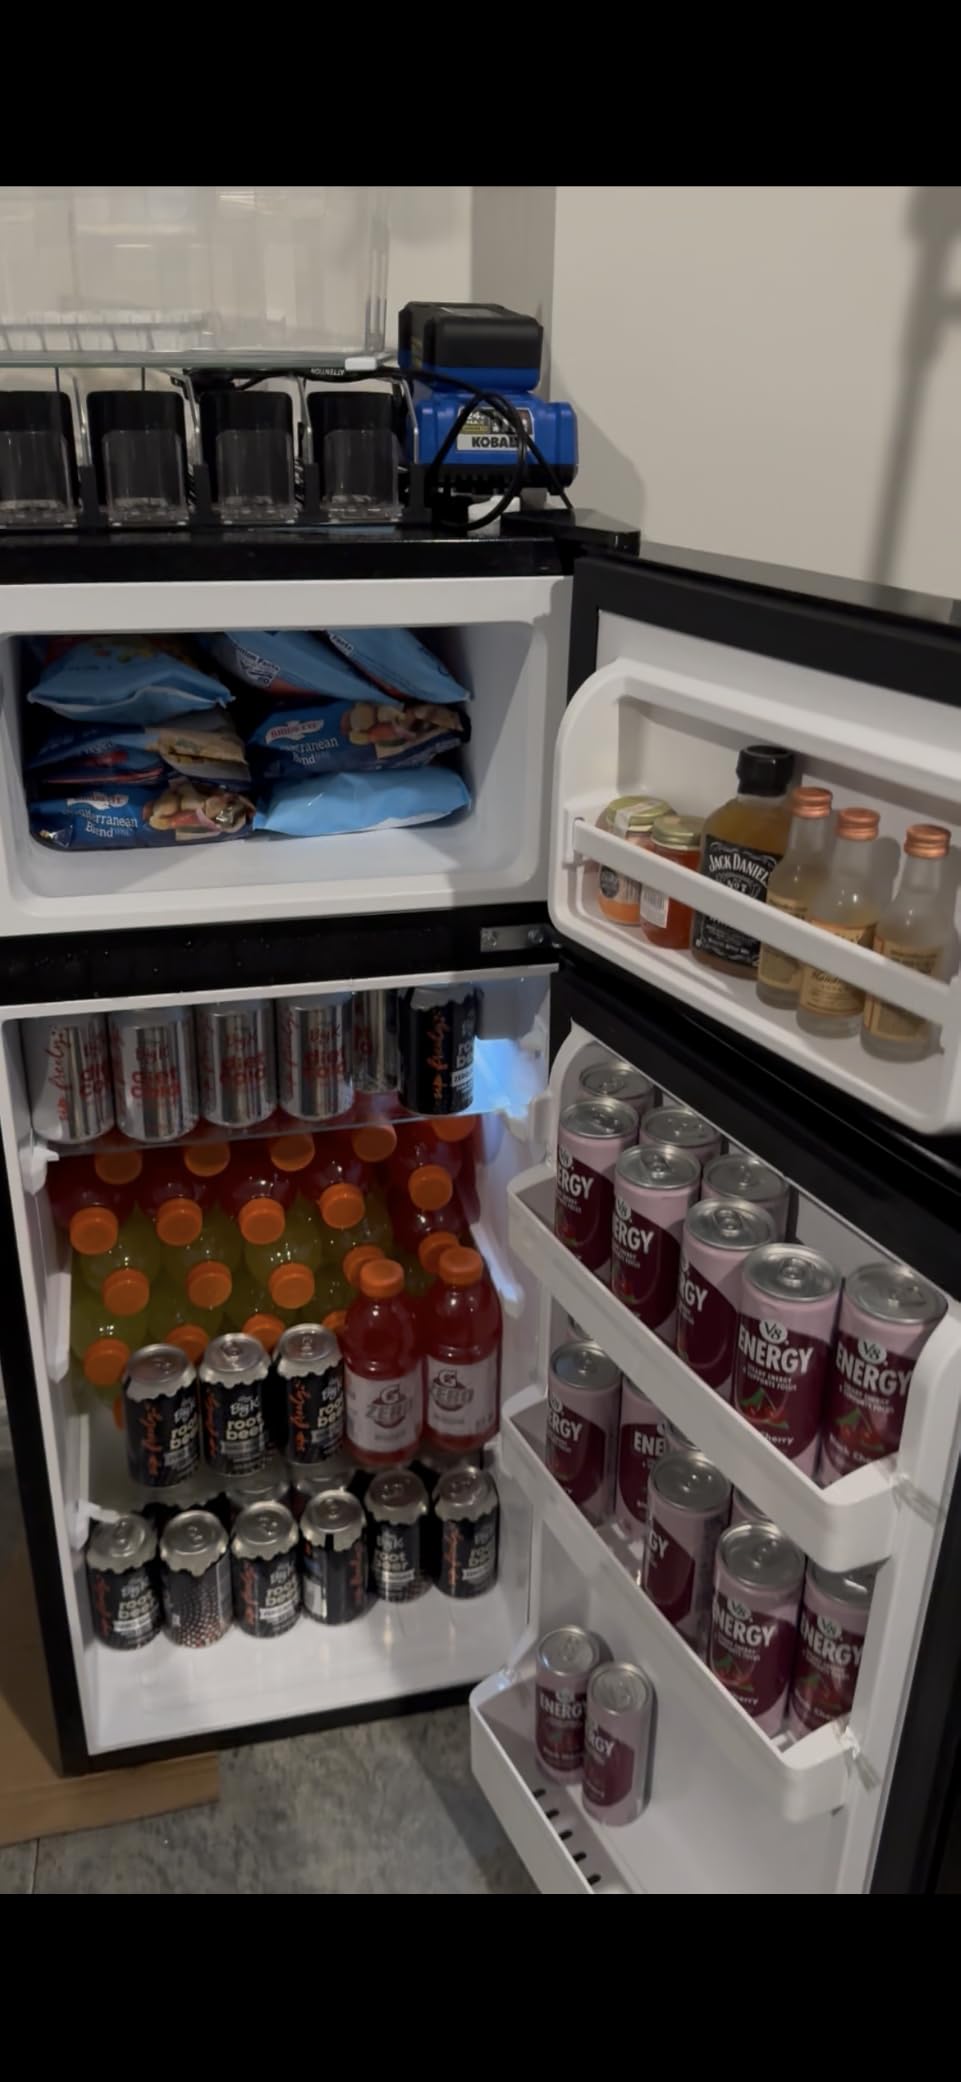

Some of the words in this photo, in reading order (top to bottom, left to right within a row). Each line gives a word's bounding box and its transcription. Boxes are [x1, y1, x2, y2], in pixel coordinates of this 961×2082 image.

[471, 436, 520, 448] KOBAL
[708, 853, 732, 872] JACK
[731, 853, 769, 887] DANIEL
[557, 1169, 595, 1200] ERGY
[613, 1223, 655, 1255] ERGY
[762, 1319, 786, 1343] V8
[737, 1323, 814, 1375] ENERGY
[860, 1340, 885, 1362] V8
[439, 1368, 458, 1389] G
[835, 1340, 914, 1397] ENERGY
[380, 1383, 401, 1405] G
[431, 1384, 474, 1405] ZERO
[366, 1396, 414, 1421] ZERO
[226, 1422, 265, 1441] beer
[227, 1414, 264, 1432] root
[548, 1412, 583, 1443] ERGY
[633, 1429, 665, 1457] ENE
[267, 1574, 298, 1597] root
[119, 1587, 153, 1611] root
